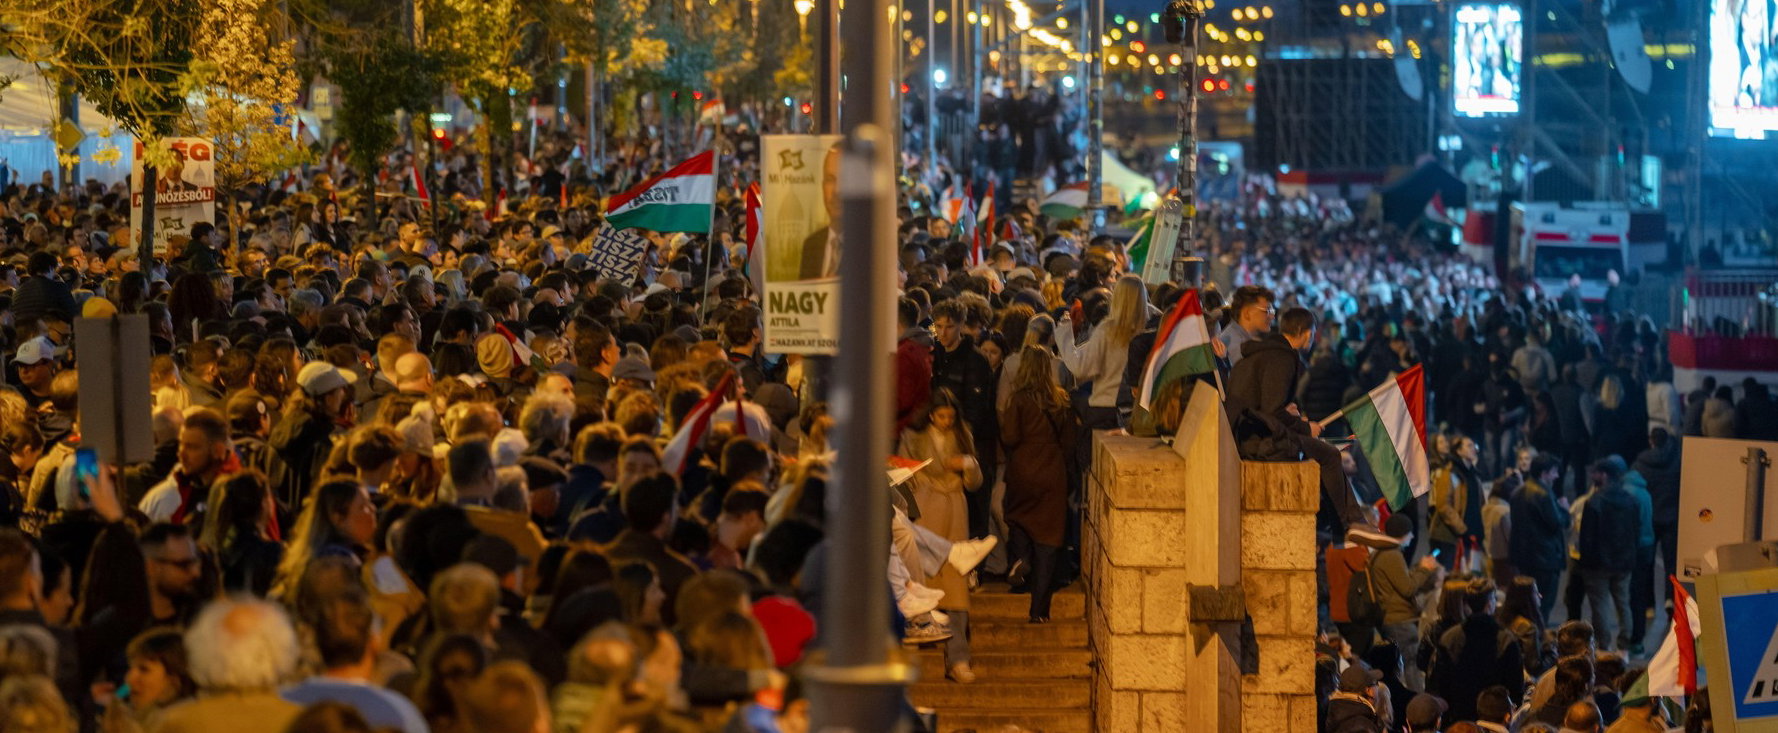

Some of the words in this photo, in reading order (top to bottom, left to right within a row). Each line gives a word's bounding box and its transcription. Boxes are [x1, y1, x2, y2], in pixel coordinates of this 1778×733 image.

[594, 235, 645, 263] TISZA
[599, 221, 650, 252] TISZA
[588, 248, 639, 277] TISZA
[769, 291, 828, 315] NAGY
[770, 317, 800, 327] ATTILA
